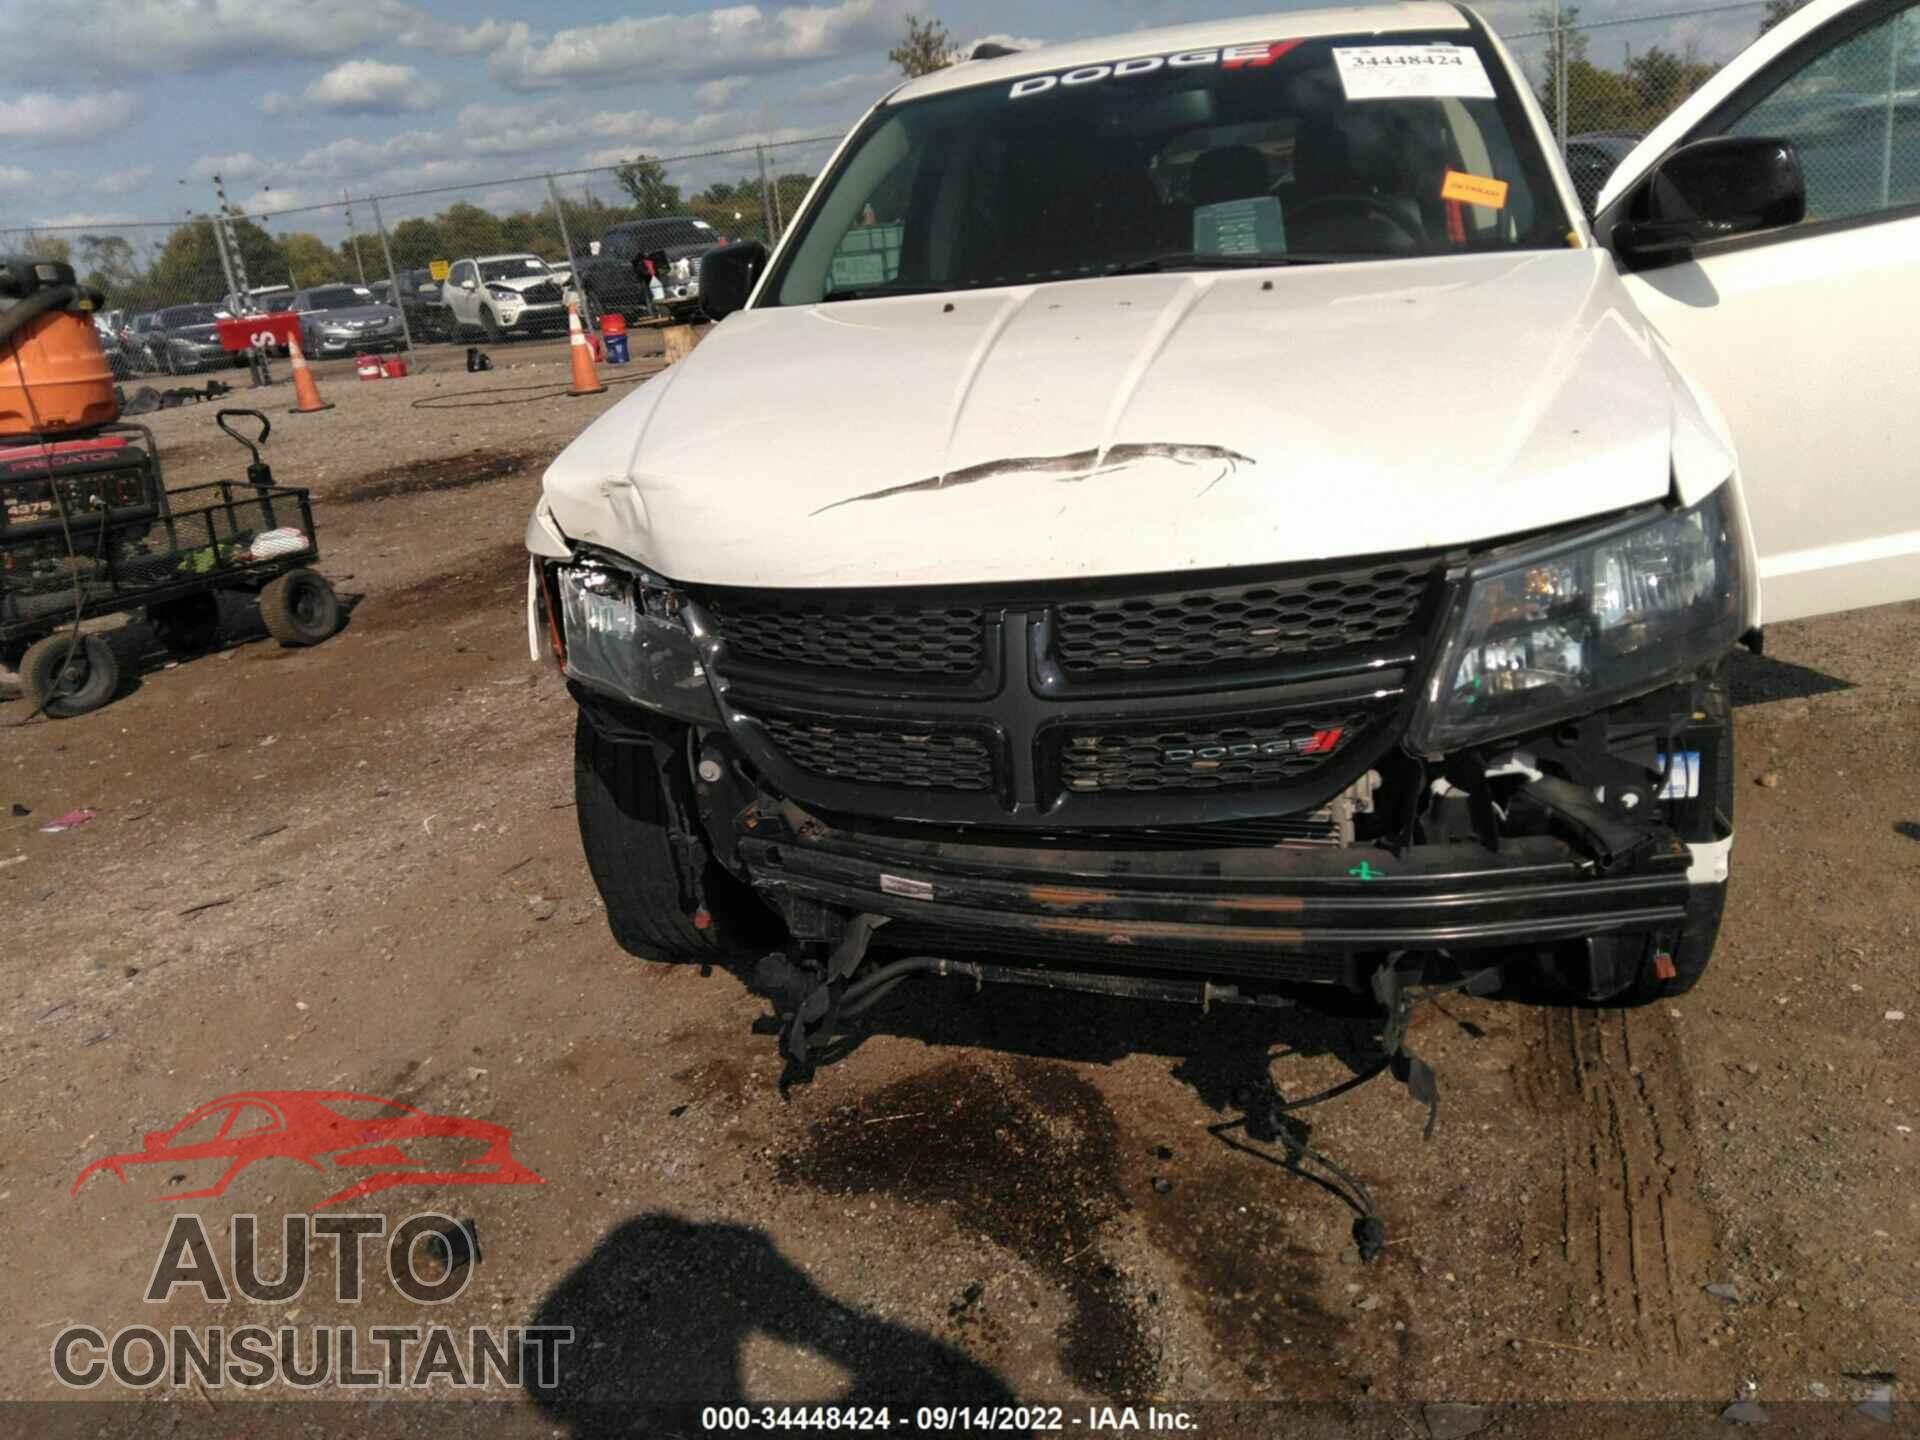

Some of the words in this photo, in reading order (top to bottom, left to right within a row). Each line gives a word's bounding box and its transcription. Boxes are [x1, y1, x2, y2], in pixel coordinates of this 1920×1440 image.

[1009, 43, 1271, 98] DODGE
[1352, 55, 1463, 66] 34448424
[1165, 737, 1322, 760] DODGE
